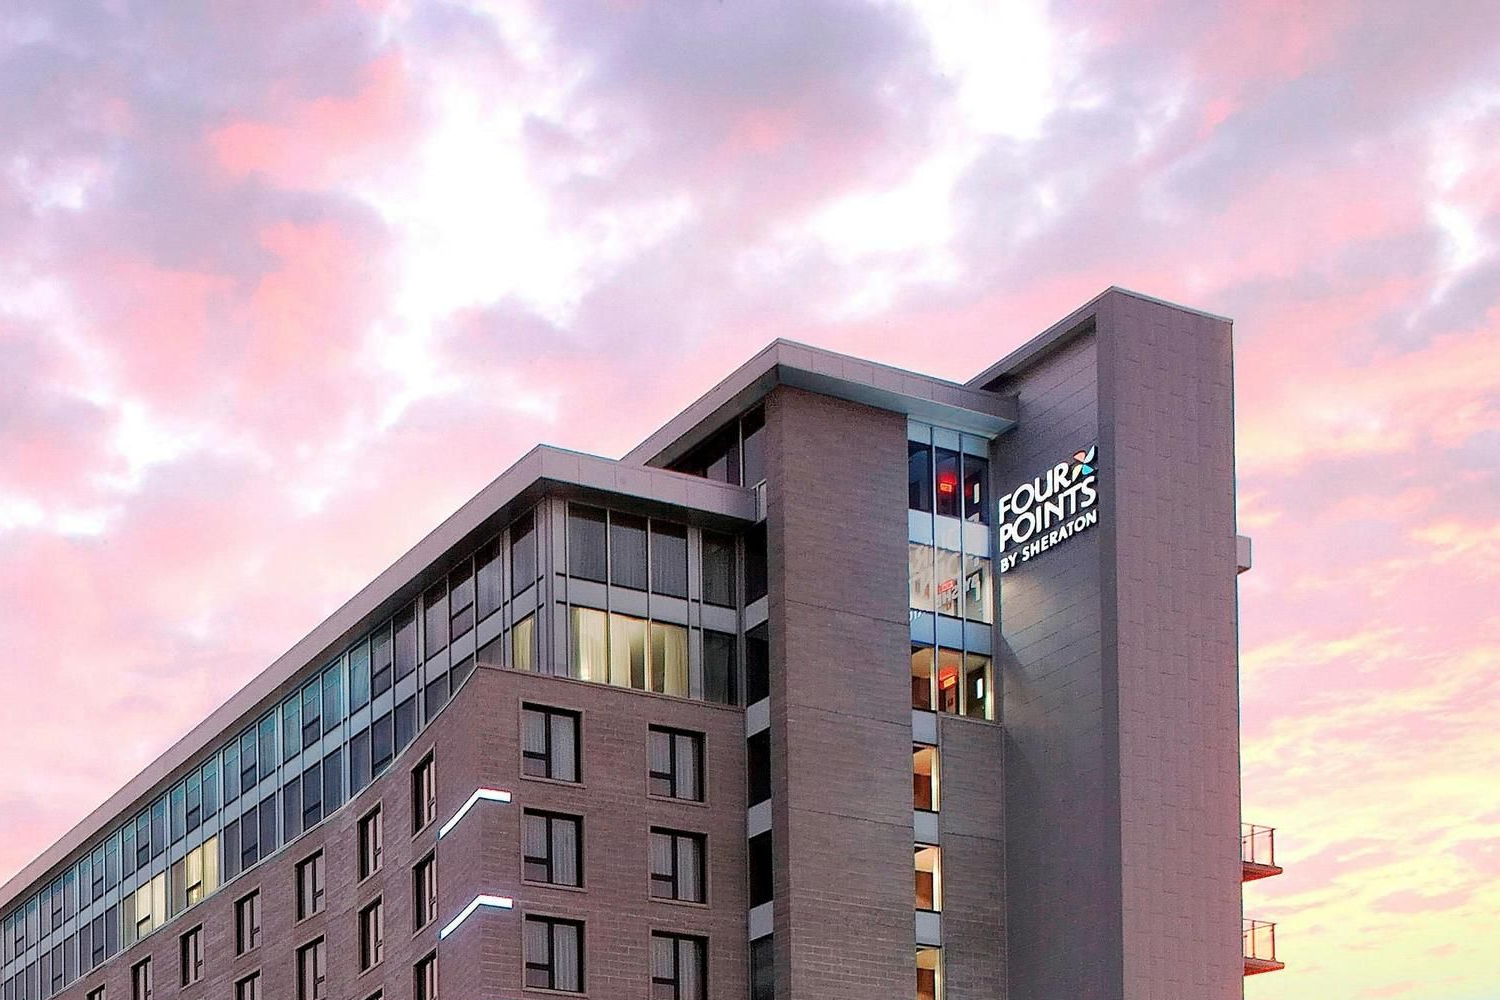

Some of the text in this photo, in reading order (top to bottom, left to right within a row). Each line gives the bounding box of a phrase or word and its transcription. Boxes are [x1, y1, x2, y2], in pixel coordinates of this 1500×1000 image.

[998, 462, 1071, 524] FOUR
[999, 475, 1097, 553] POINTS
[1000, 509, 1097, 573] BY SHERATON
